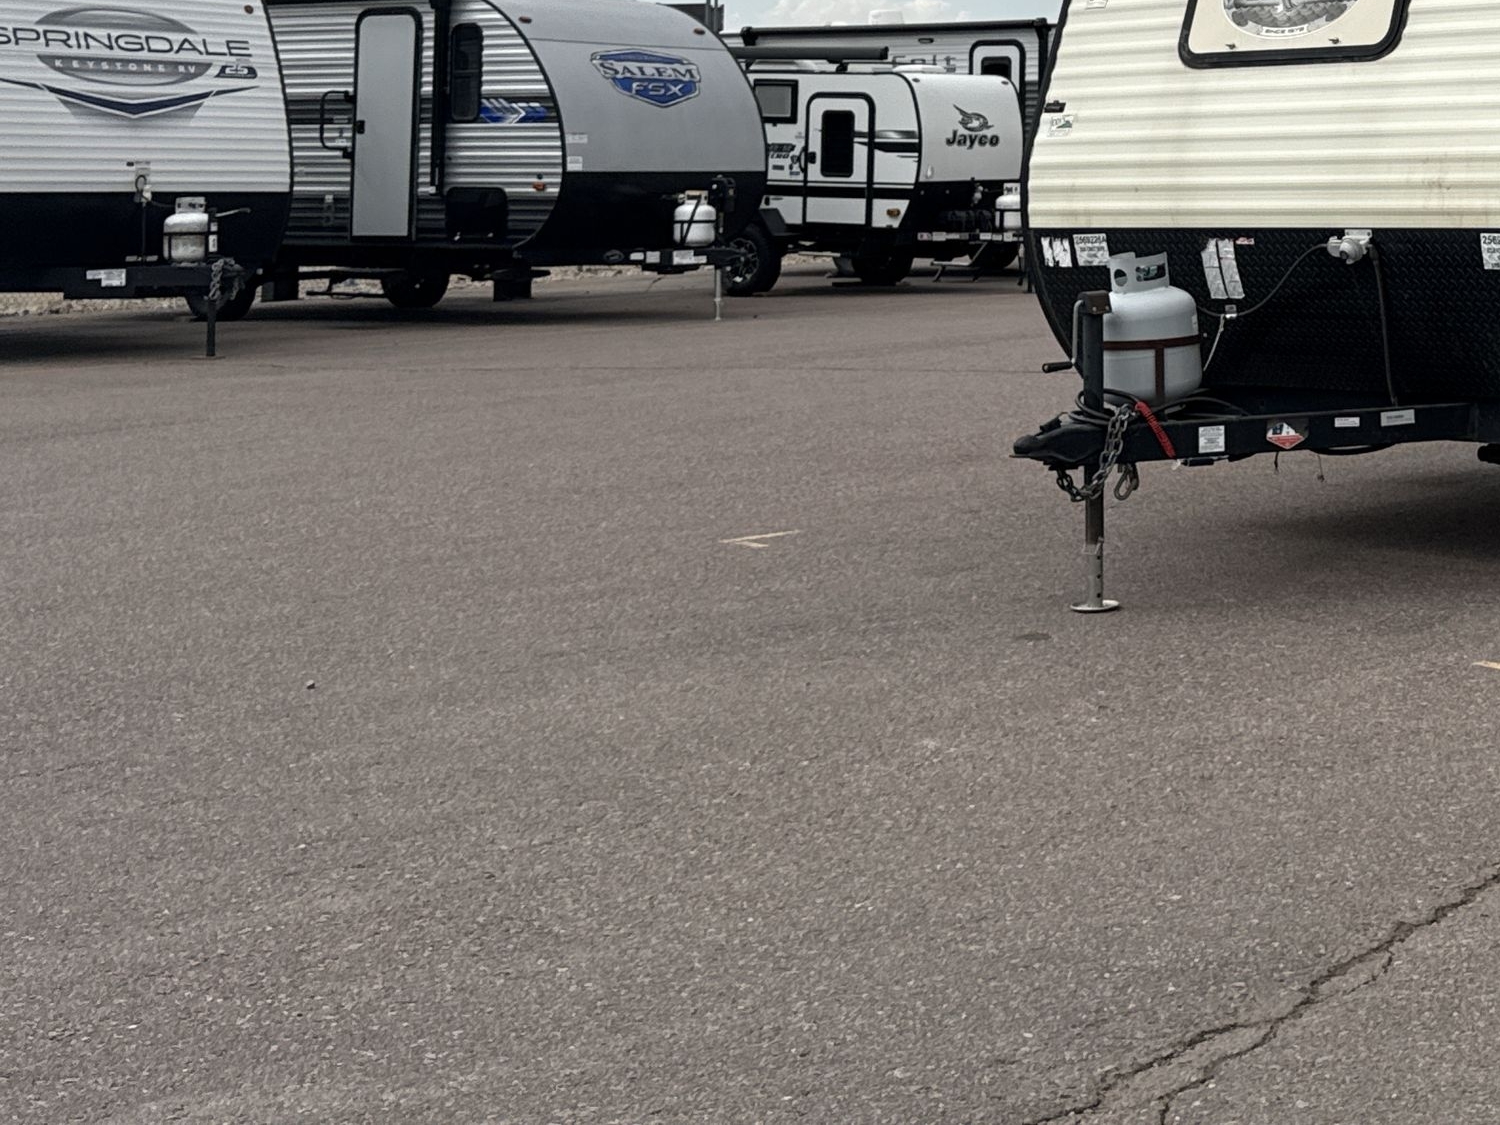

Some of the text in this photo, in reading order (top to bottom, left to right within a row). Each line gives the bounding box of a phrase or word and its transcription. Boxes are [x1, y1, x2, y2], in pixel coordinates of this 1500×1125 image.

[53, 58, 197, 75] KEYSTONE RV
[599, 61, 698, 81] SALEM
[631, 81, 685, 96] FSX
[945, 129, 1000, 151] Jayco
